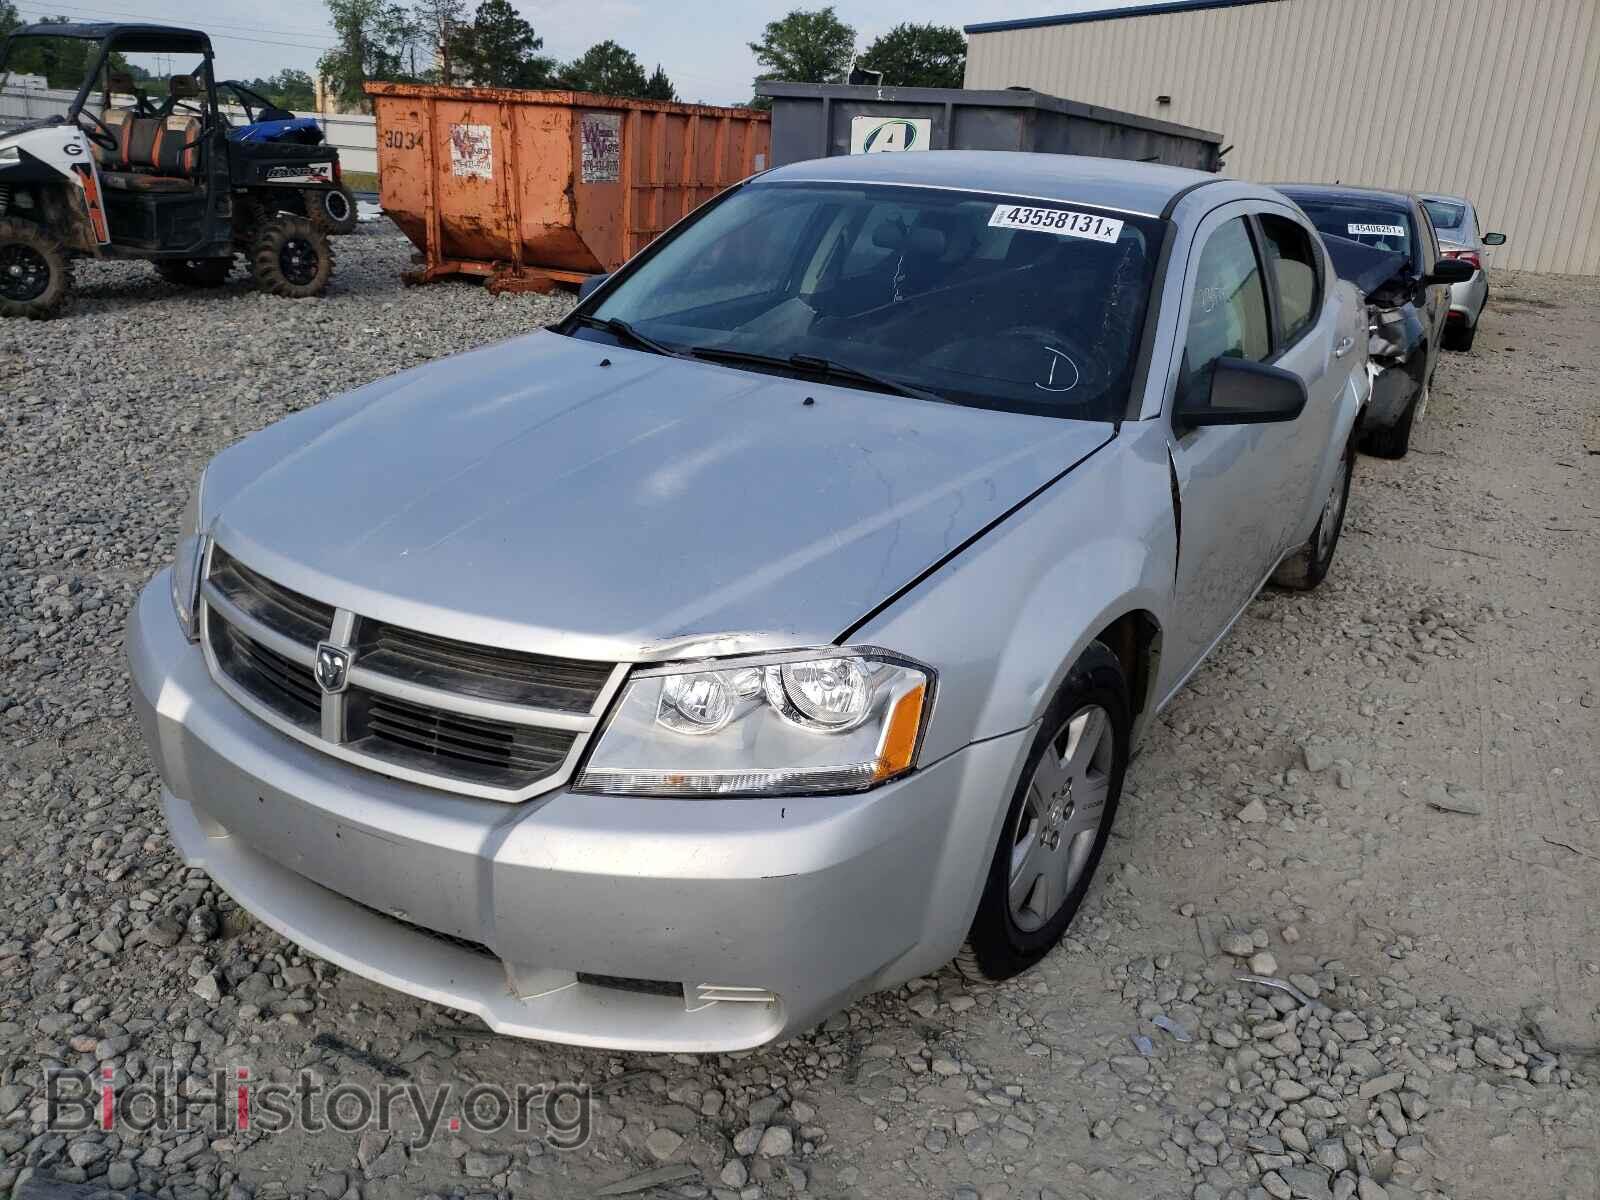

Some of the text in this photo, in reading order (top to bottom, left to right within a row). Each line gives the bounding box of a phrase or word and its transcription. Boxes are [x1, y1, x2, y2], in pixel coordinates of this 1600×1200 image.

[63, 143, 83, 156] G
[384, 129, 425, 150] 3034
[1007, 207, 1104, 235] 43558131
[1034, 346, 1079, 392] D
